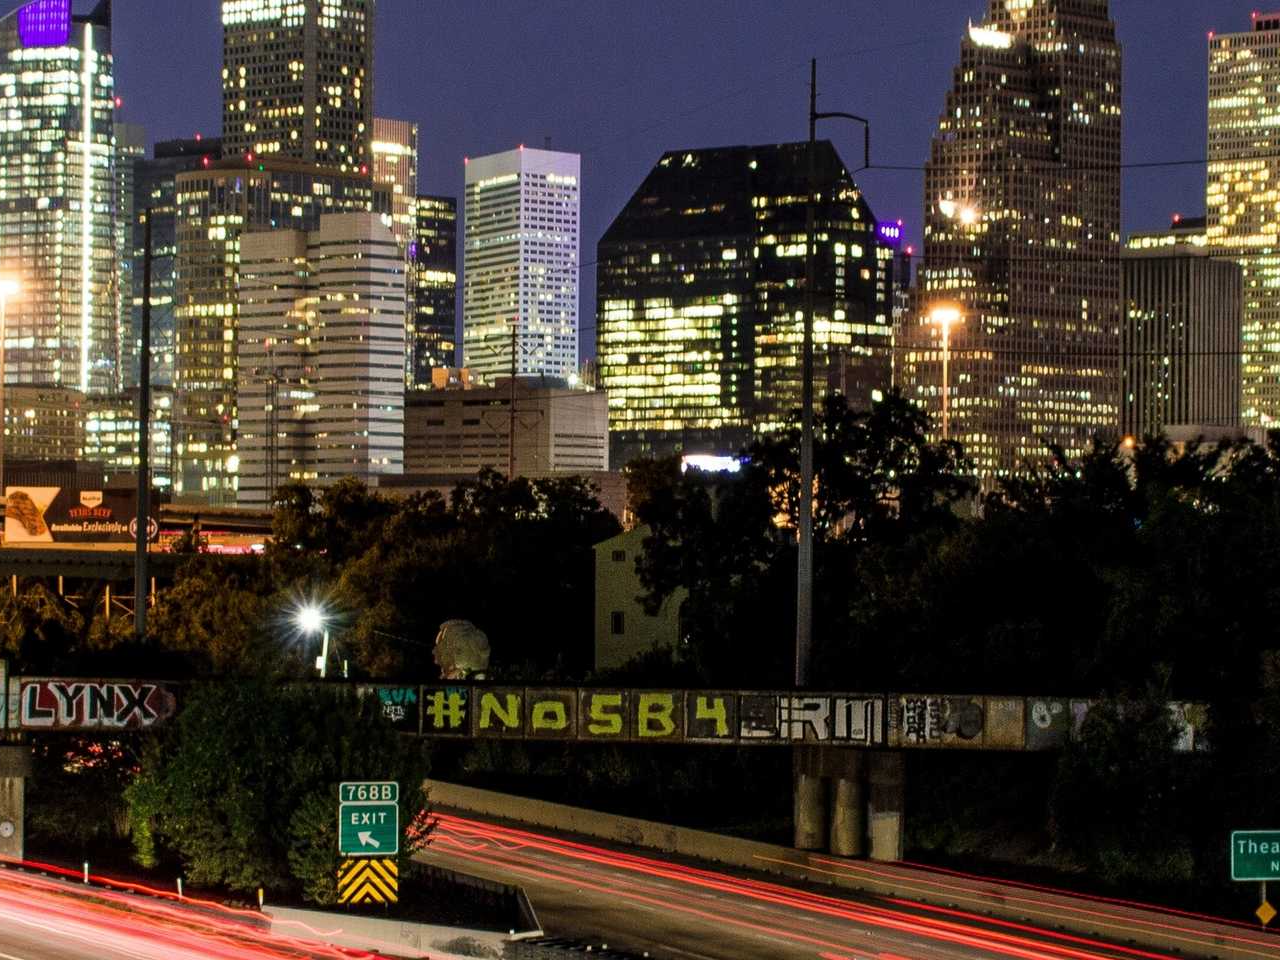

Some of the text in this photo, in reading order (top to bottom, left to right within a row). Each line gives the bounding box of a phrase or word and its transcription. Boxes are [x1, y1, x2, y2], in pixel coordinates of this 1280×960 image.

[82, 520, 122, 534] Exclusively
[19, 682, 159, 727] LYNX
[347, 785, 392, 801] 768B
[351, 812, 387, 825] EXIT
